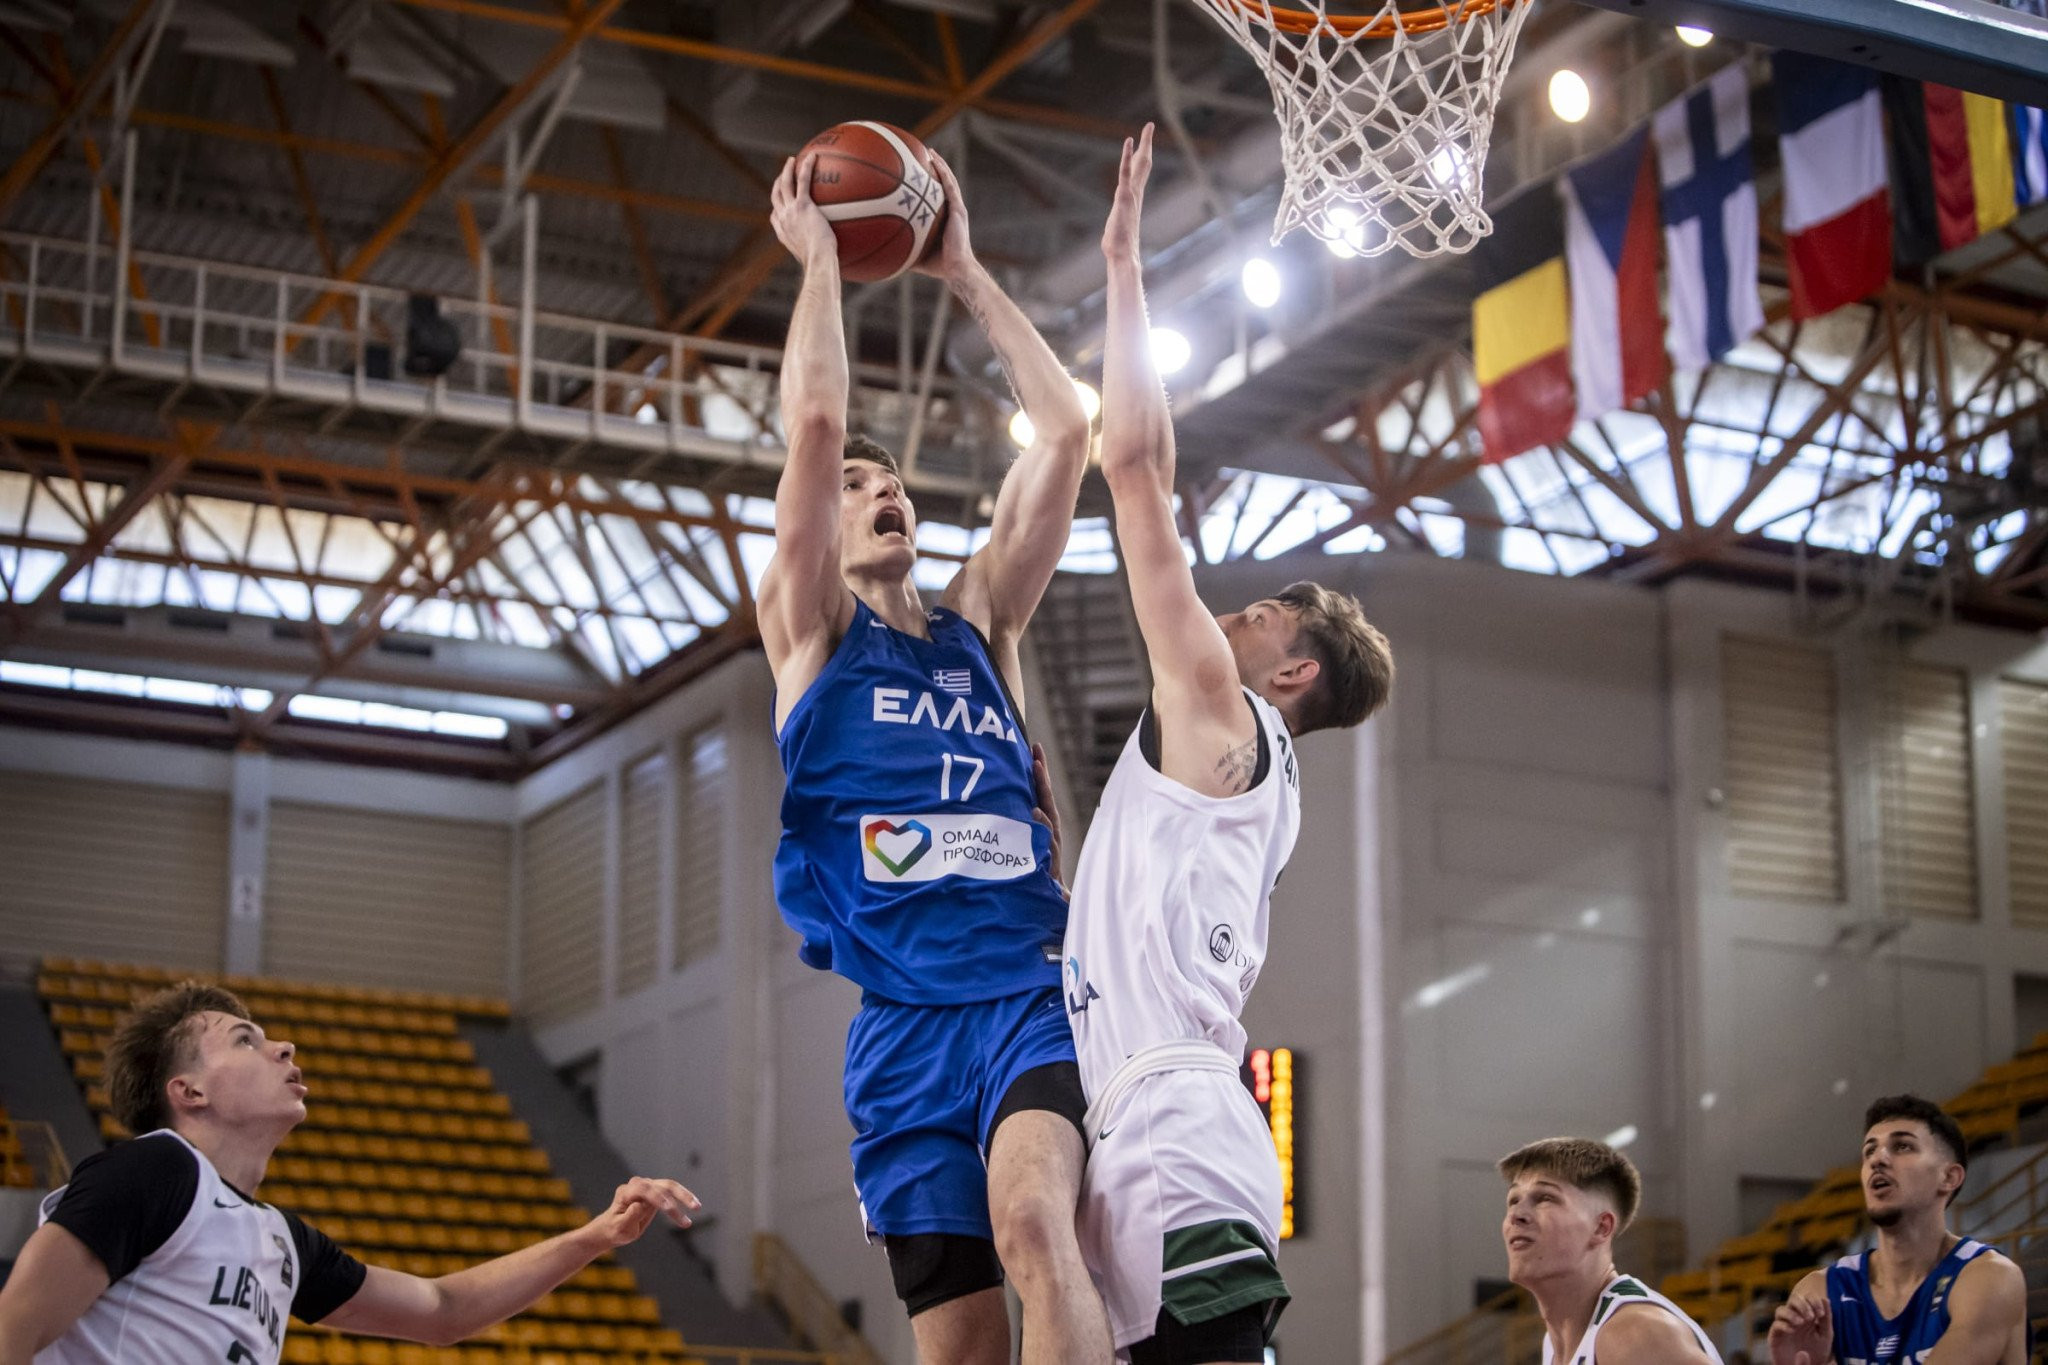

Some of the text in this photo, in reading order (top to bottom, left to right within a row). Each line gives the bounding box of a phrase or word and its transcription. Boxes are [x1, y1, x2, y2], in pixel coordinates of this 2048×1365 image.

[940, 753, 985, 802] 17
[943, 829, 999, 846] ΟΜΑΔΑ
[944, 846, 1031, 868] ΠΡΟΣΦΟΡΑΣ
